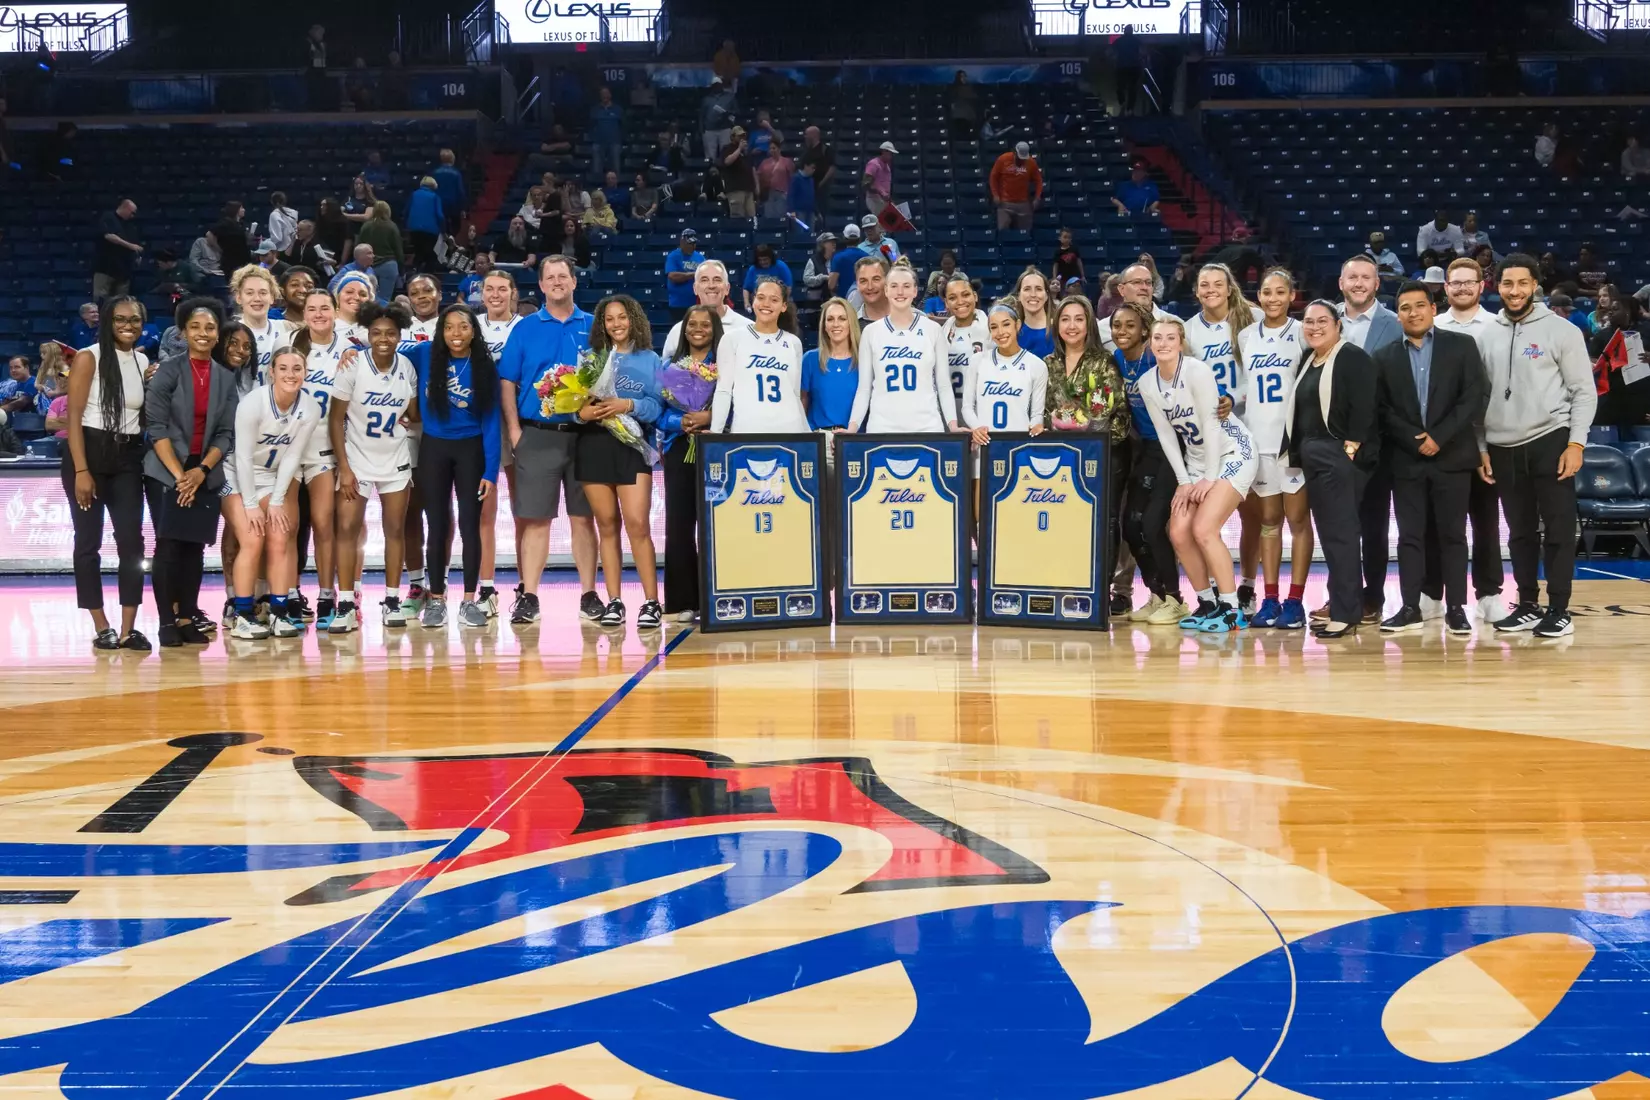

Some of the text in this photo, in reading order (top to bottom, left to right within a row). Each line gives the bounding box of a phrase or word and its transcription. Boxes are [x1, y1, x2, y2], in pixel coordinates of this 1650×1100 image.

[554, 3, 631, 16] LEXUS
[21, 12, 97, 26] LEXUS
[544, 32, 618, 42] LEXUS OF TUA
[1086, 24, 1111, 33] EXUS
[1132, 24, 1157, 33] ULSA
[604, 69, 626, 81] 105
[1060, 63, 1082, 75] 105
[1212, 74, 1236, 86] 106
[442, 83, 466, 97] 104
[880, 346, 923, 361] Tulsa
[1202, 341, 1232, 361] Tuls
[746, 354, 789, 371] Tulsa
[1249, 353, 1292, 371] Tulsa
[885, 364, 917, 392] 20
[1212, 360, 1237, 389] 21
[615, 375, 644, 392] lsa
[756, 373, 782, 403] 13
[981, 381, 1024, 397] Tulsa
[1256, 373, 1283, 403] 12
[361, 391, 404, 407] Tulsa
[992, 401, 1008, 429] 0
[366, 411, 397, 438] 24
[264, 449, 278, 469] 1
[741, 489, 786, 506] Tulsa
[879, 488, 926, 504] Tulsa
[1022, 487, 1067, 504] Tulsa
[755, 512, 773, 534] 13
[890, 509, 915, 530] 20
[1037, 510, 1049, 532] 0
